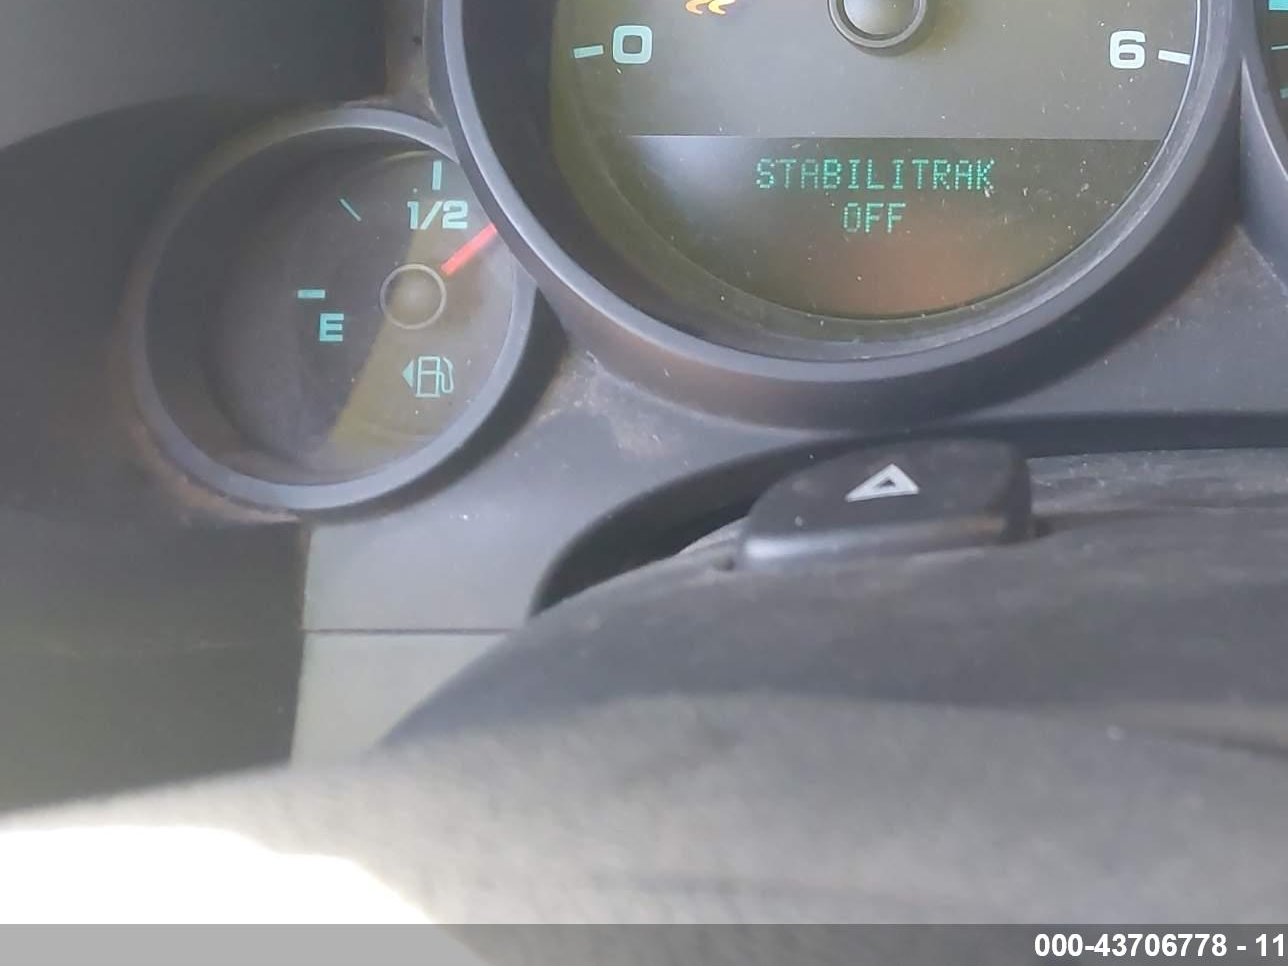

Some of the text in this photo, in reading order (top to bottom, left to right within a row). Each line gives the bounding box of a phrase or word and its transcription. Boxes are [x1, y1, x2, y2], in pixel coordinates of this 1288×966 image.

[612, 25, 652, 64] 0
[1109, 30, 1146, 69] 6
[755, 158, 995, 189] STABILITRAK
[407, 200, 468, 230] 1/2
[842, 203, 906, 233] OFF
[319, 313, 344, 342] E
